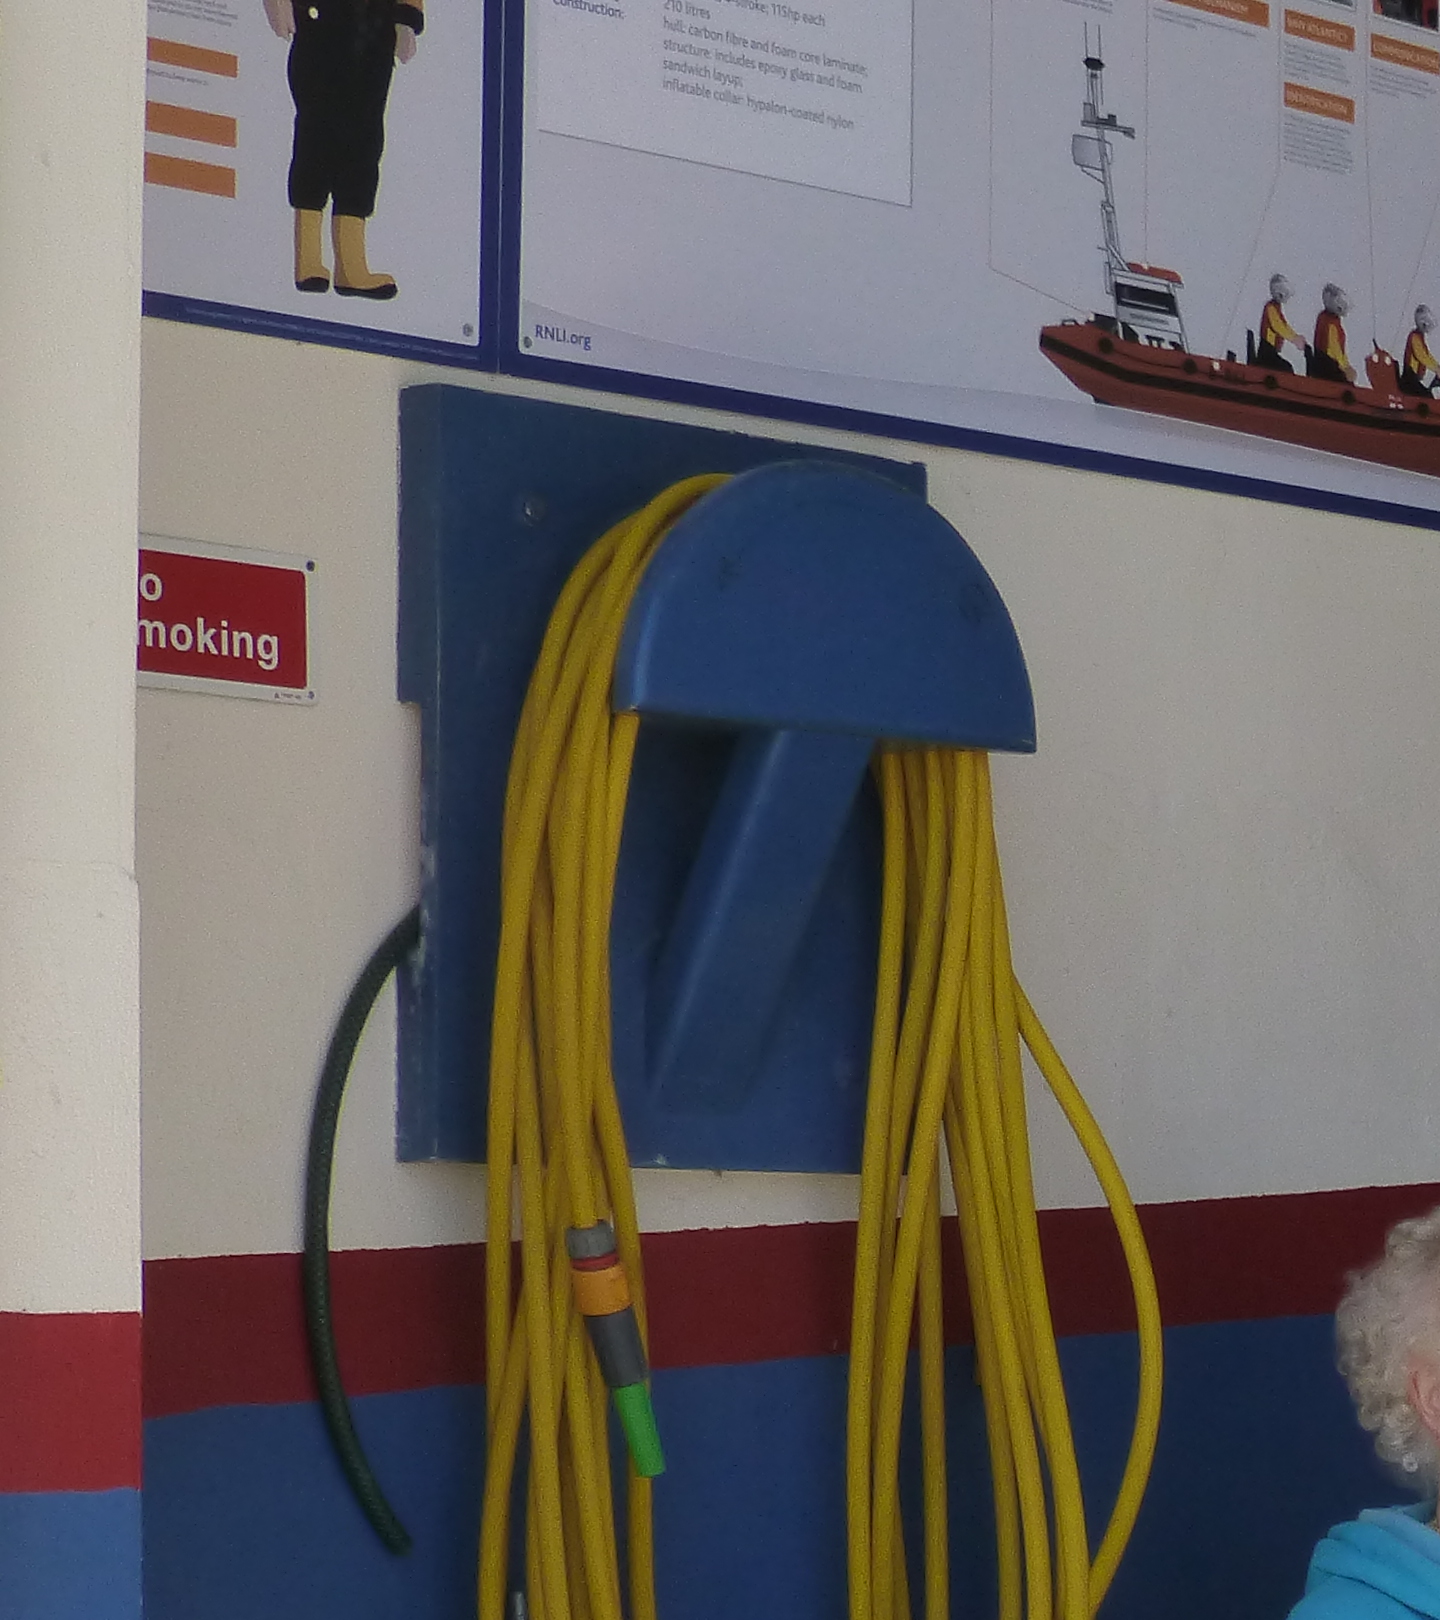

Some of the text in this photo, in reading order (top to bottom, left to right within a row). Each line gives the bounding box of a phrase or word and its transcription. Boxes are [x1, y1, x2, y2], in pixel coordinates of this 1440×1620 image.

[688, 23, 723, 43] carbon
[663, 58, 711, 80] sandwich
[662, 76, 711, 100] inflatable
[535, 324, 592, 351] RNLI.org
[140, 573, 163, 601] o
[138, 616, 279, 671] moking
